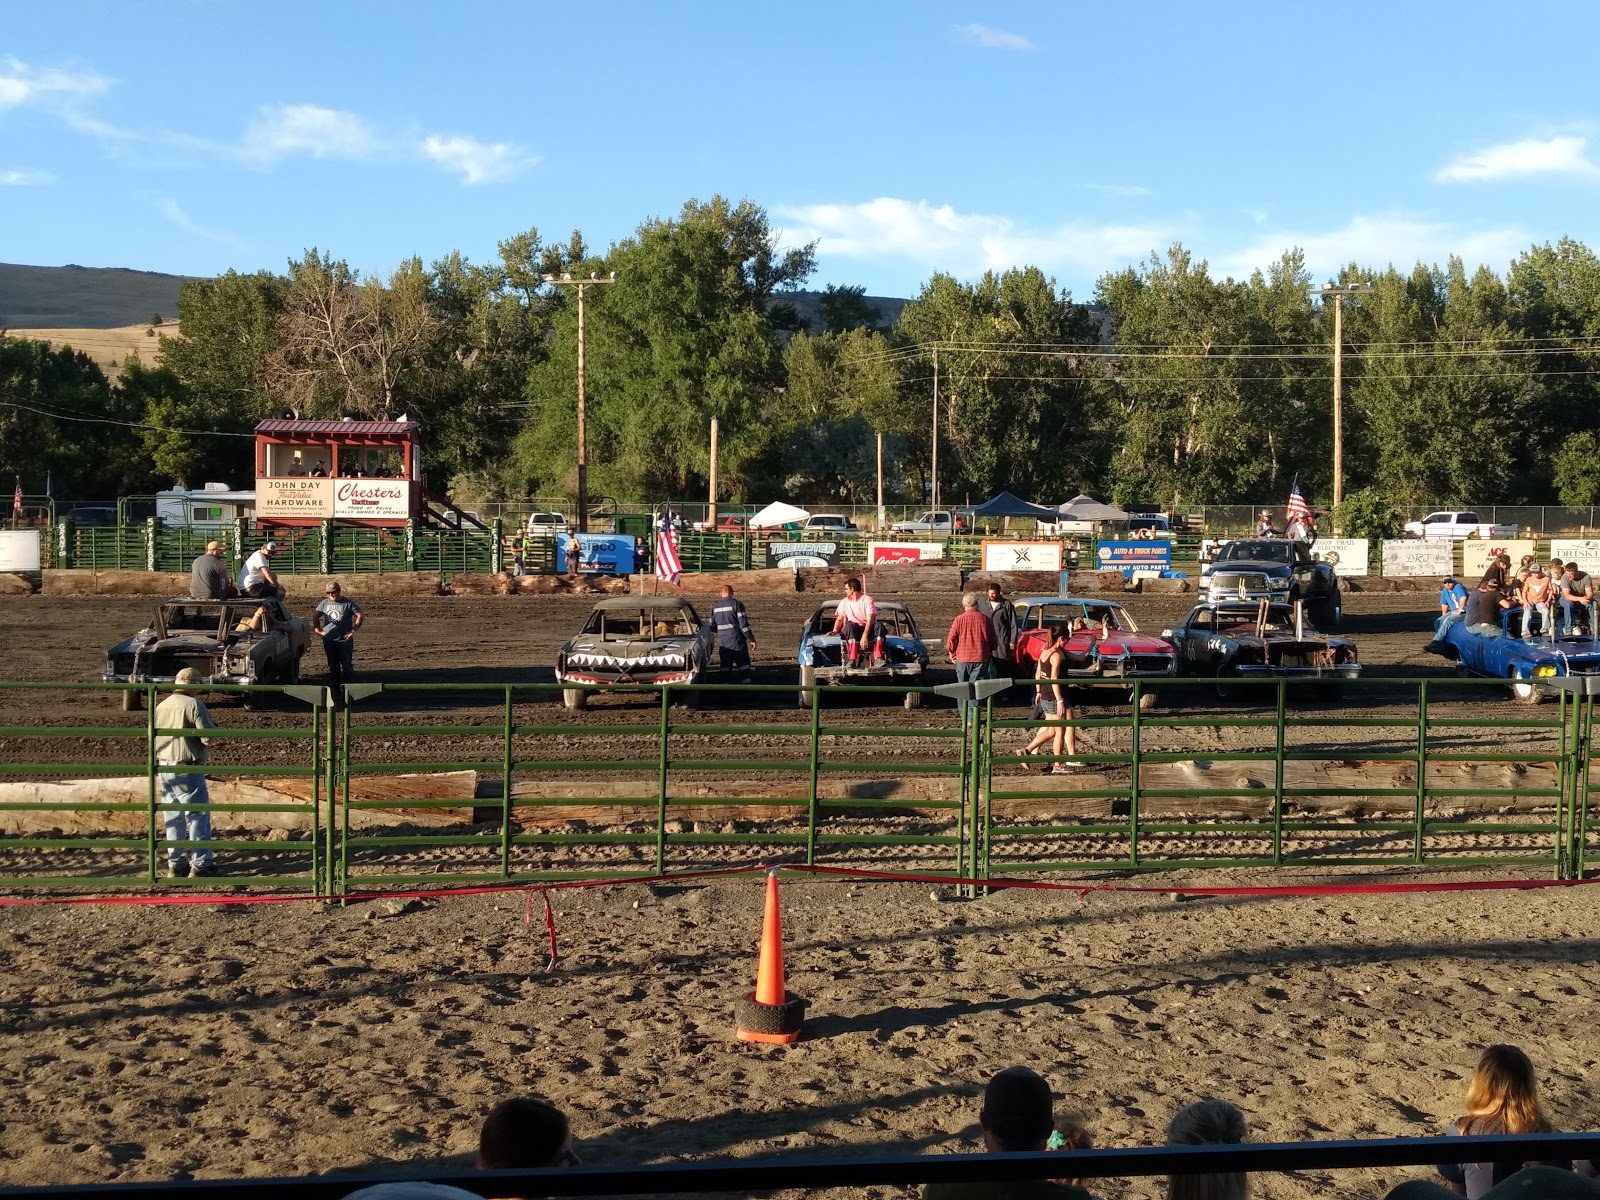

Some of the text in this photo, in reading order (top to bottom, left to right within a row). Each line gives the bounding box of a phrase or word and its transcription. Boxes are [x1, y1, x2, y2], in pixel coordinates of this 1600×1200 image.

[338, 483, 403, 501] Chester's
[580, 542, 616, 551] GIBCO
[770, 543, 836, 555] TIDEWATER
[1488, 547, 1508, 556] ACE
[1238, 577, 1246, 600] 66
